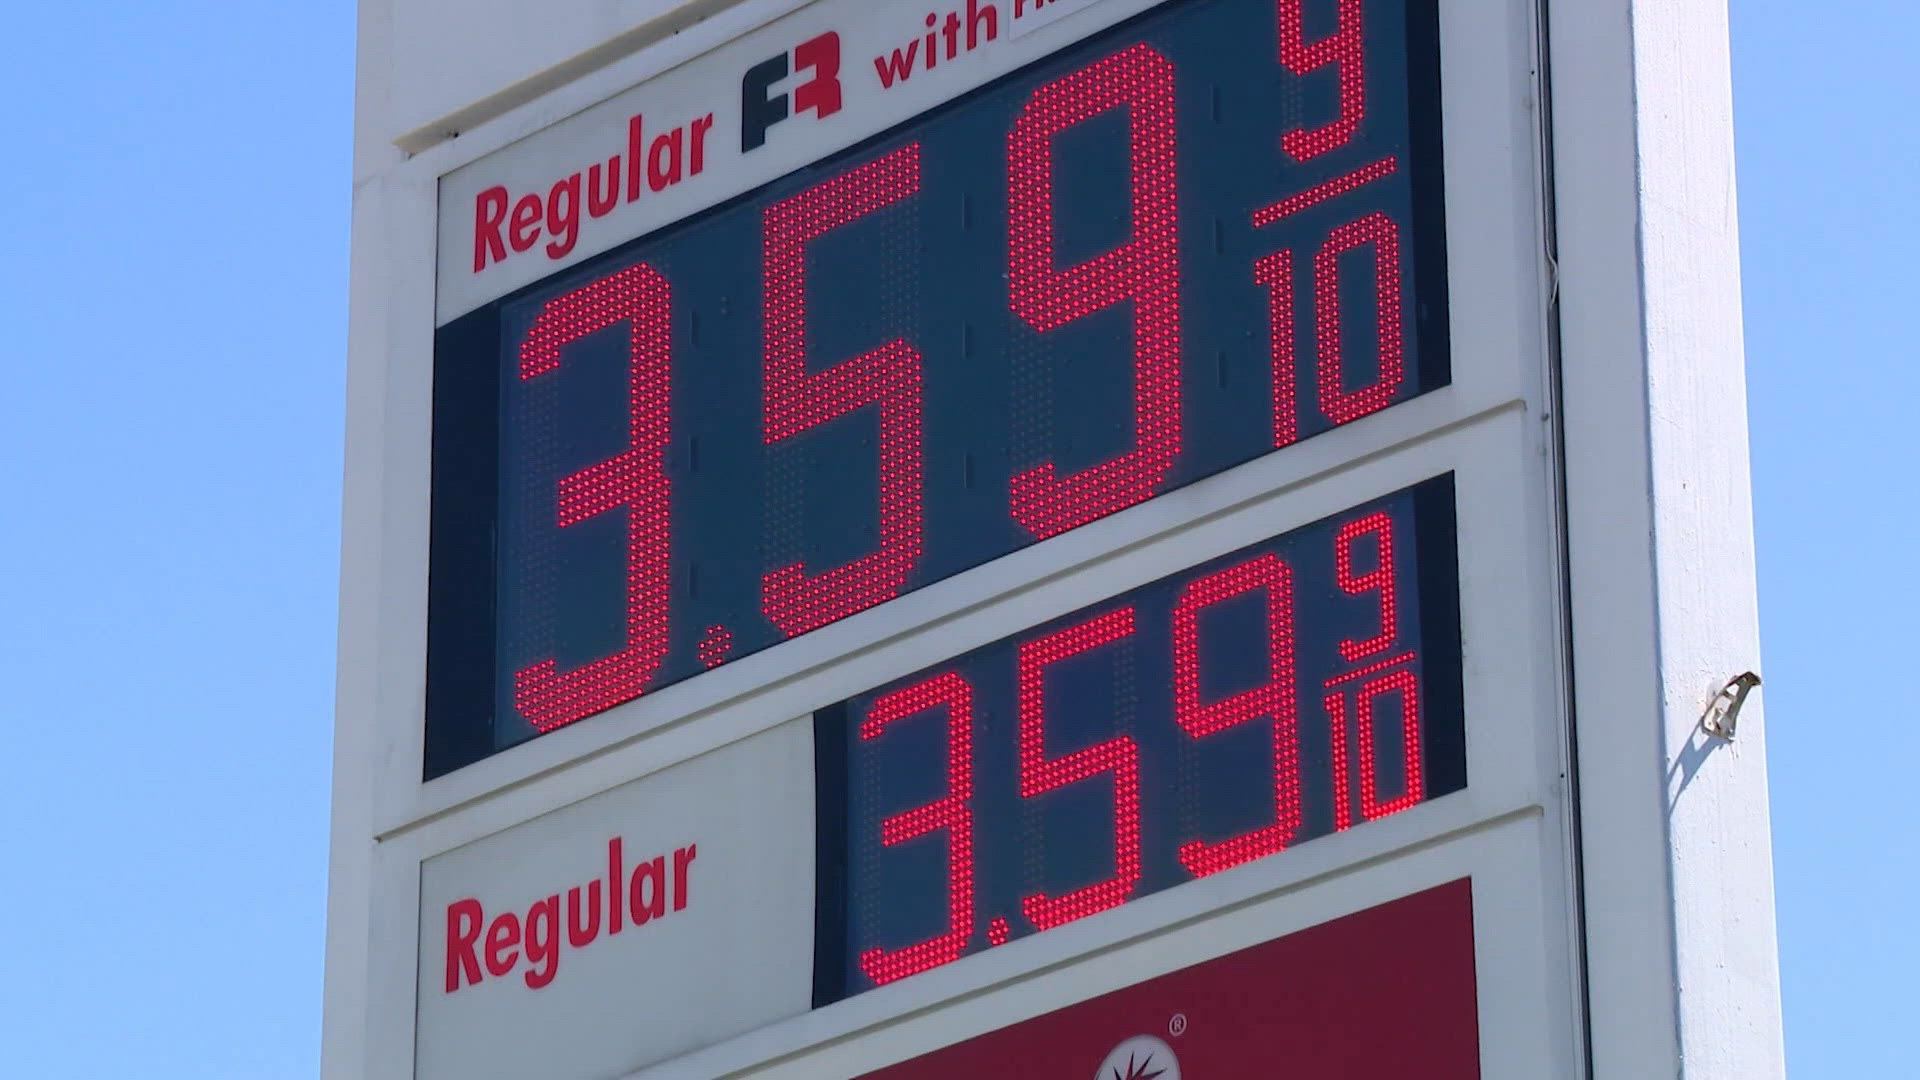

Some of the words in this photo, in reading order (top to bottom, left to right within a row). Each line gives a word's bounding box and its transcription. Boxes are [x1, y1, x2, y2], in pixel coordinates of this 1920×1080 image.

[473, 113, 713, 274] Regular
[874, 0, 997, 90] with
[515, 42, 1184, 734] 3.59
[1335, 511, 1396, 661] 9
[860, 552, 1302, 985] 3.59
[446, 836, 696, 994] Regular
